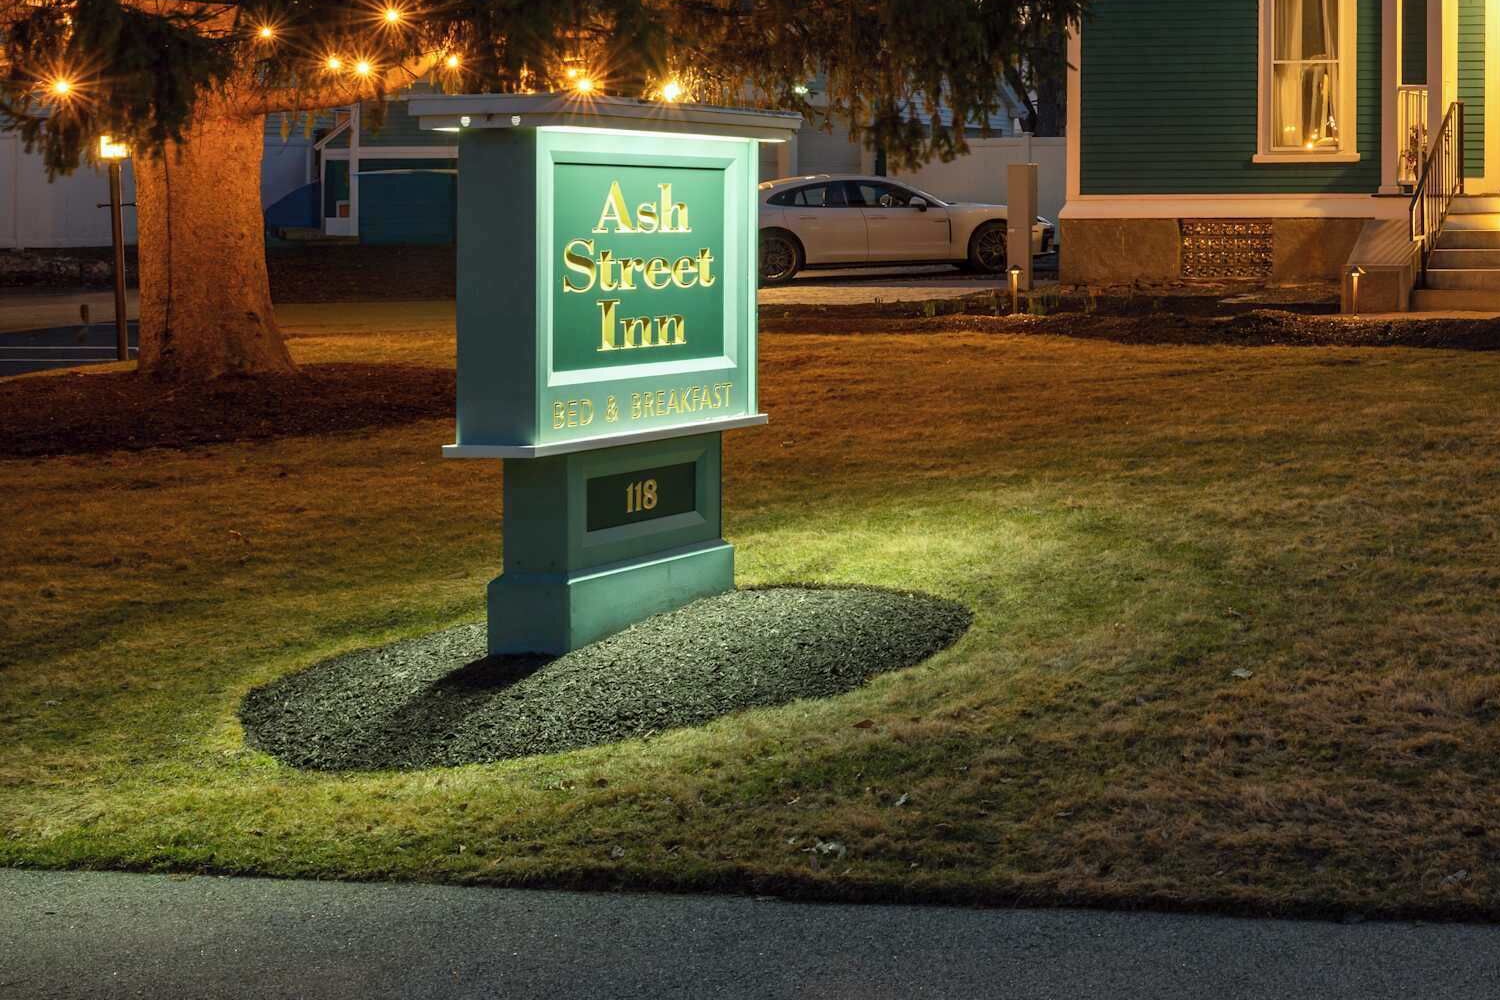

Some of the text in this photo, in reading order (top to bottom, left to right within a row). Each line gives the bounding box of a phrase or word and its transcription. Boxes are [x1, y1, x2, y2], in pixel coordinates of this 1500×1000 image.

[592, 180, 692, 234] Ash
[563, 238, 716, 293] Street
[597, 299, 687, 352] Inn
[552, 382, 733, 430] BED & BREAKFAST
[626, 479, 657, 513] 118
